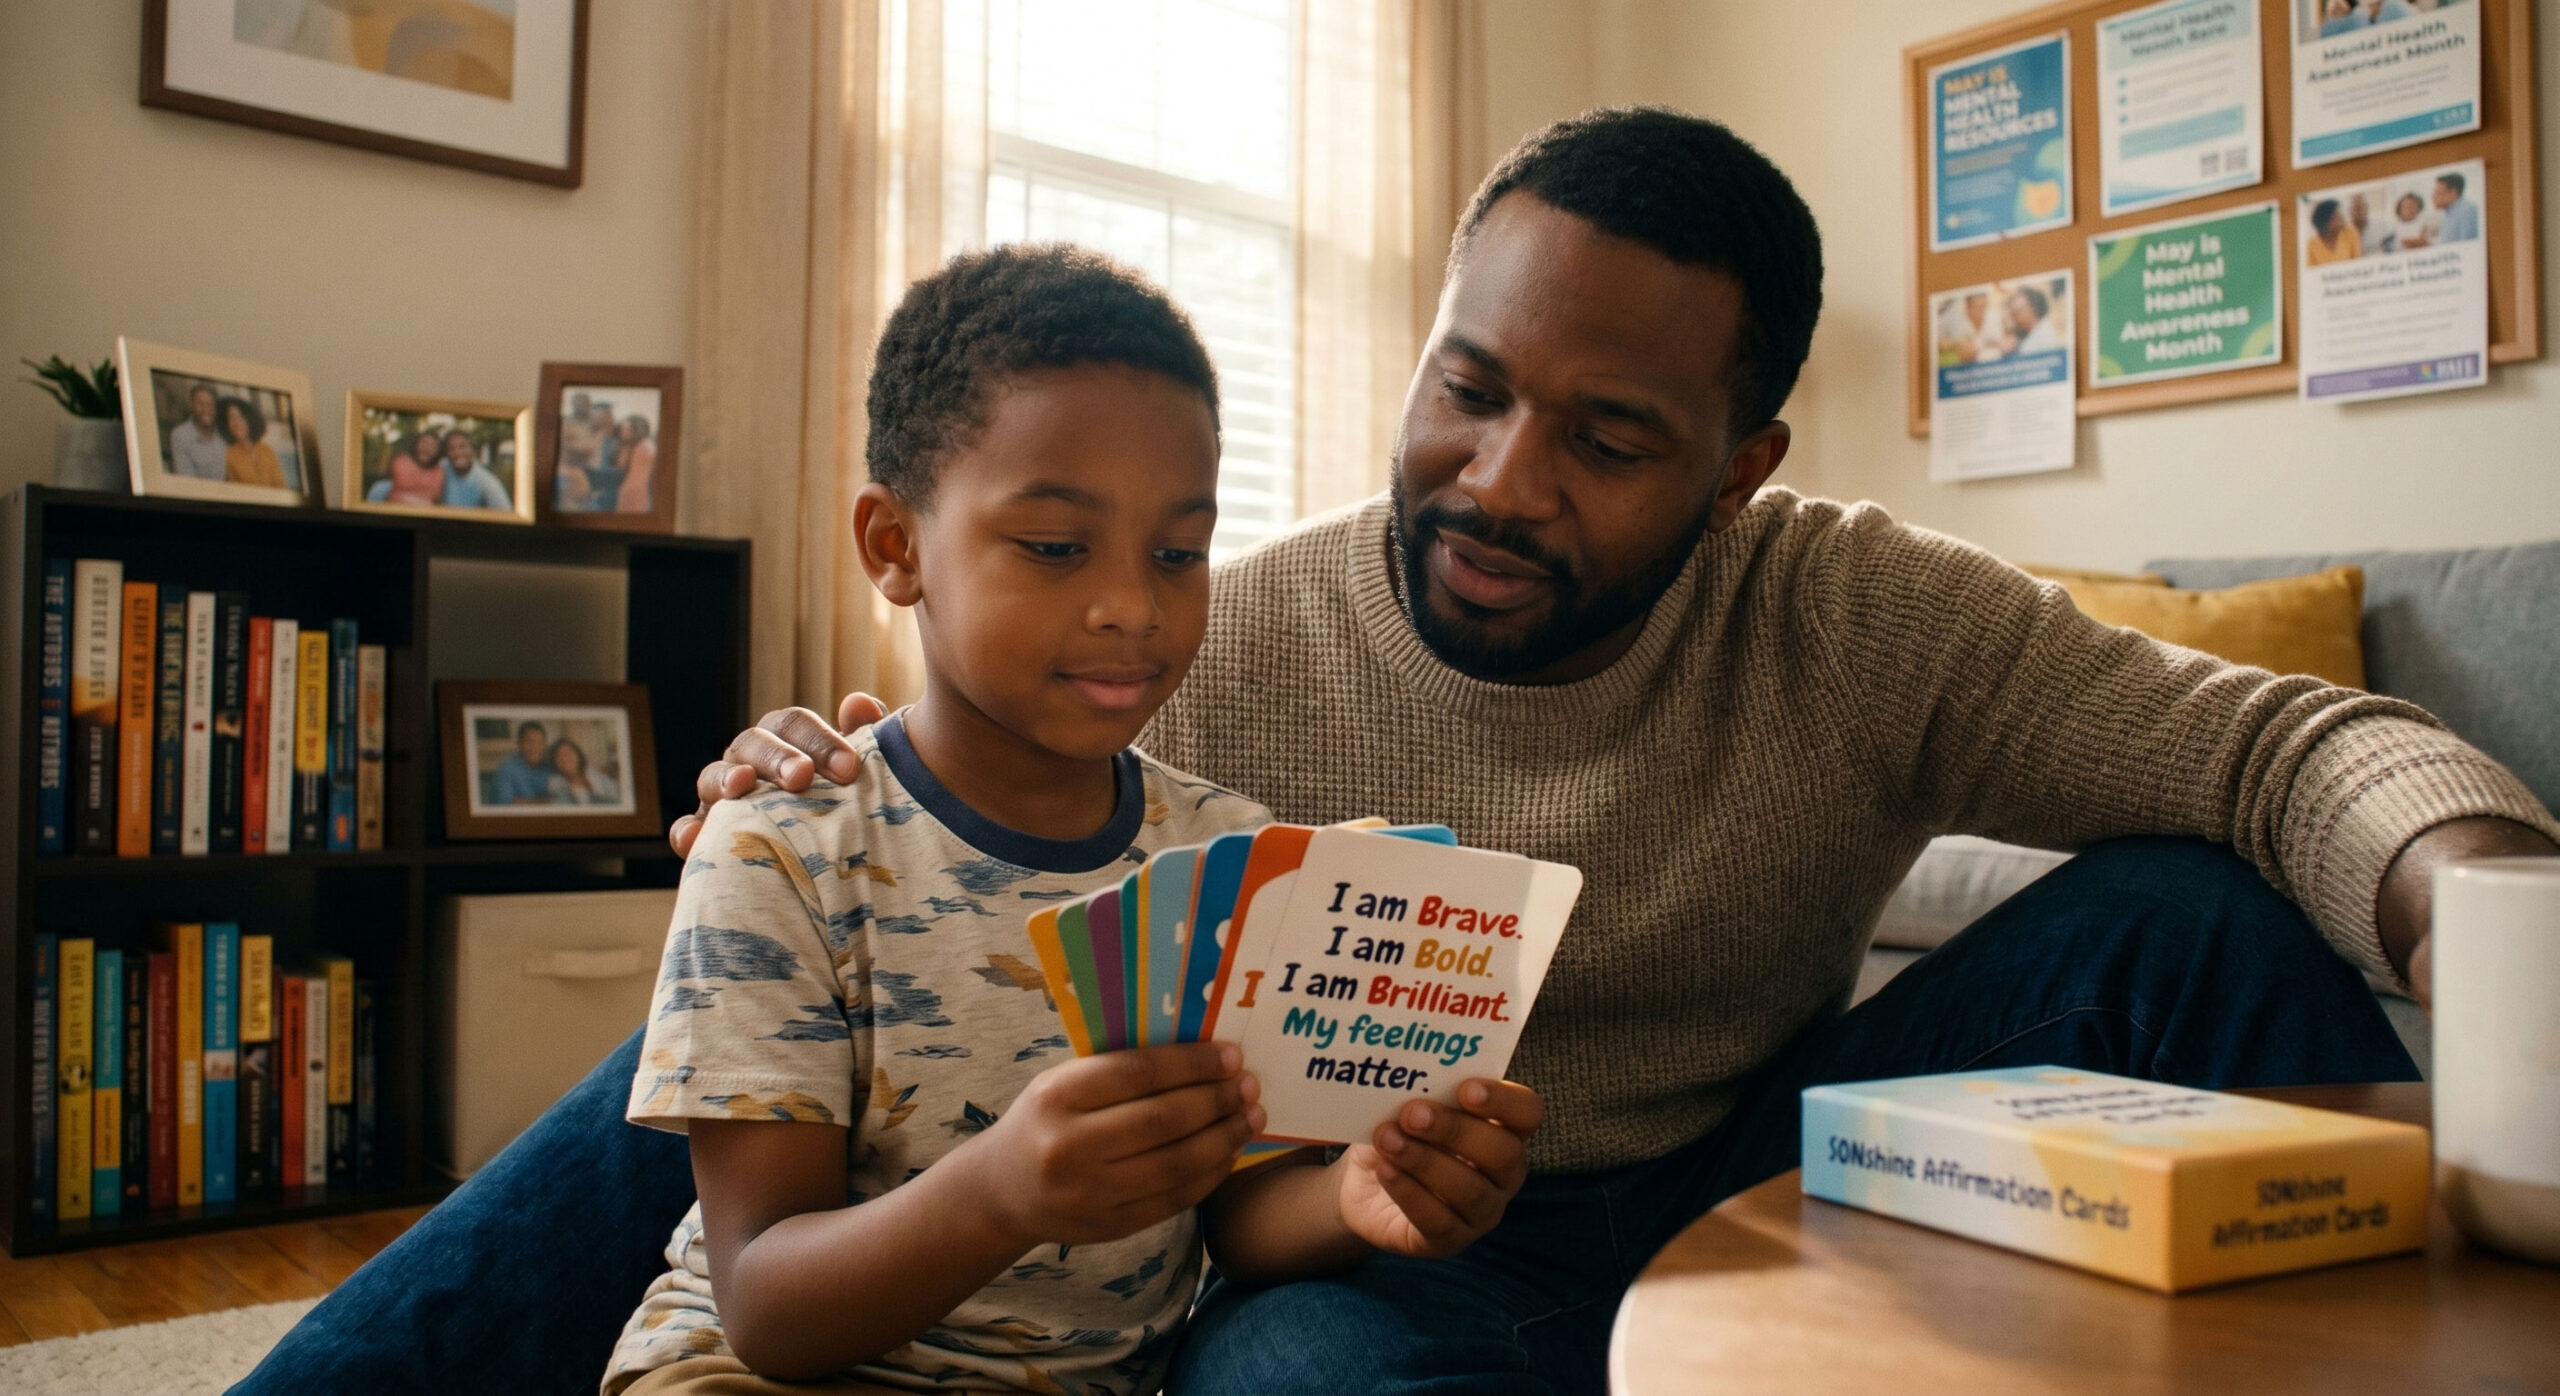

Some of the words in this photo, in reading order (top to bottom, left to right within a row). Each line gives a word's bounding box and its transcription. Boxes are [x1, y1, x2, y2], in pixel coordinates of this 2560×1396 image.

[2307, 54, 2401, 82] Awareness
[2406, 34, 2466, 58] Month
[2322, 36, 2381, 61] Mental
[2387, 20, 2447, 45] Health
[1944, 71, 1985, 94] MAY
[1989, 63, 2007, 84] IS
[1944, 80, 2023, 114] MENTAL
[1944, 100, 2020, 132] HEALTH
[1944, 107, 2058, 153] RESOURCES
[2145, 240, 2195, 265] May
[2201, 232, 2222, 255] is
[2143, 255, 2225, 289] Mental
[2144, 282, 2223, 315] Health
[2120, 306, 2250, 342] Awareness
[2145, 331, 2223, 362] Month
[1327, 882, 1351, 913] I
[1355, 893, 1408, 922] am
[1417, 895, 1523, 940] Brave.
[1324, 926, 1349, 956] I
[1352, 937, 1405, 965] am
[1414, 938, 1493, 978] Bold.
[1236, 970, 1265, 1009] I
[1278, 963, 1302, 992] I
[1305, 973, 1358, 1001] am
[1366, 975, 1510, 1023] Brilliant.
[1282, 1006, 1338, 1050] My
[1348, 1013, 1484, 1067] feelings
[1305, 1055, 1429, 1093] matter.
[1828, 1136, 1917, 1179] SONshine
[1922, 1157, 2053, 1212] Affirmation
[2060, 1186, 2131, 1230] Cards
[2211, 1213, 2329, 1248] Affirmation
[2335, 1201, 2390, 1234] Cards
